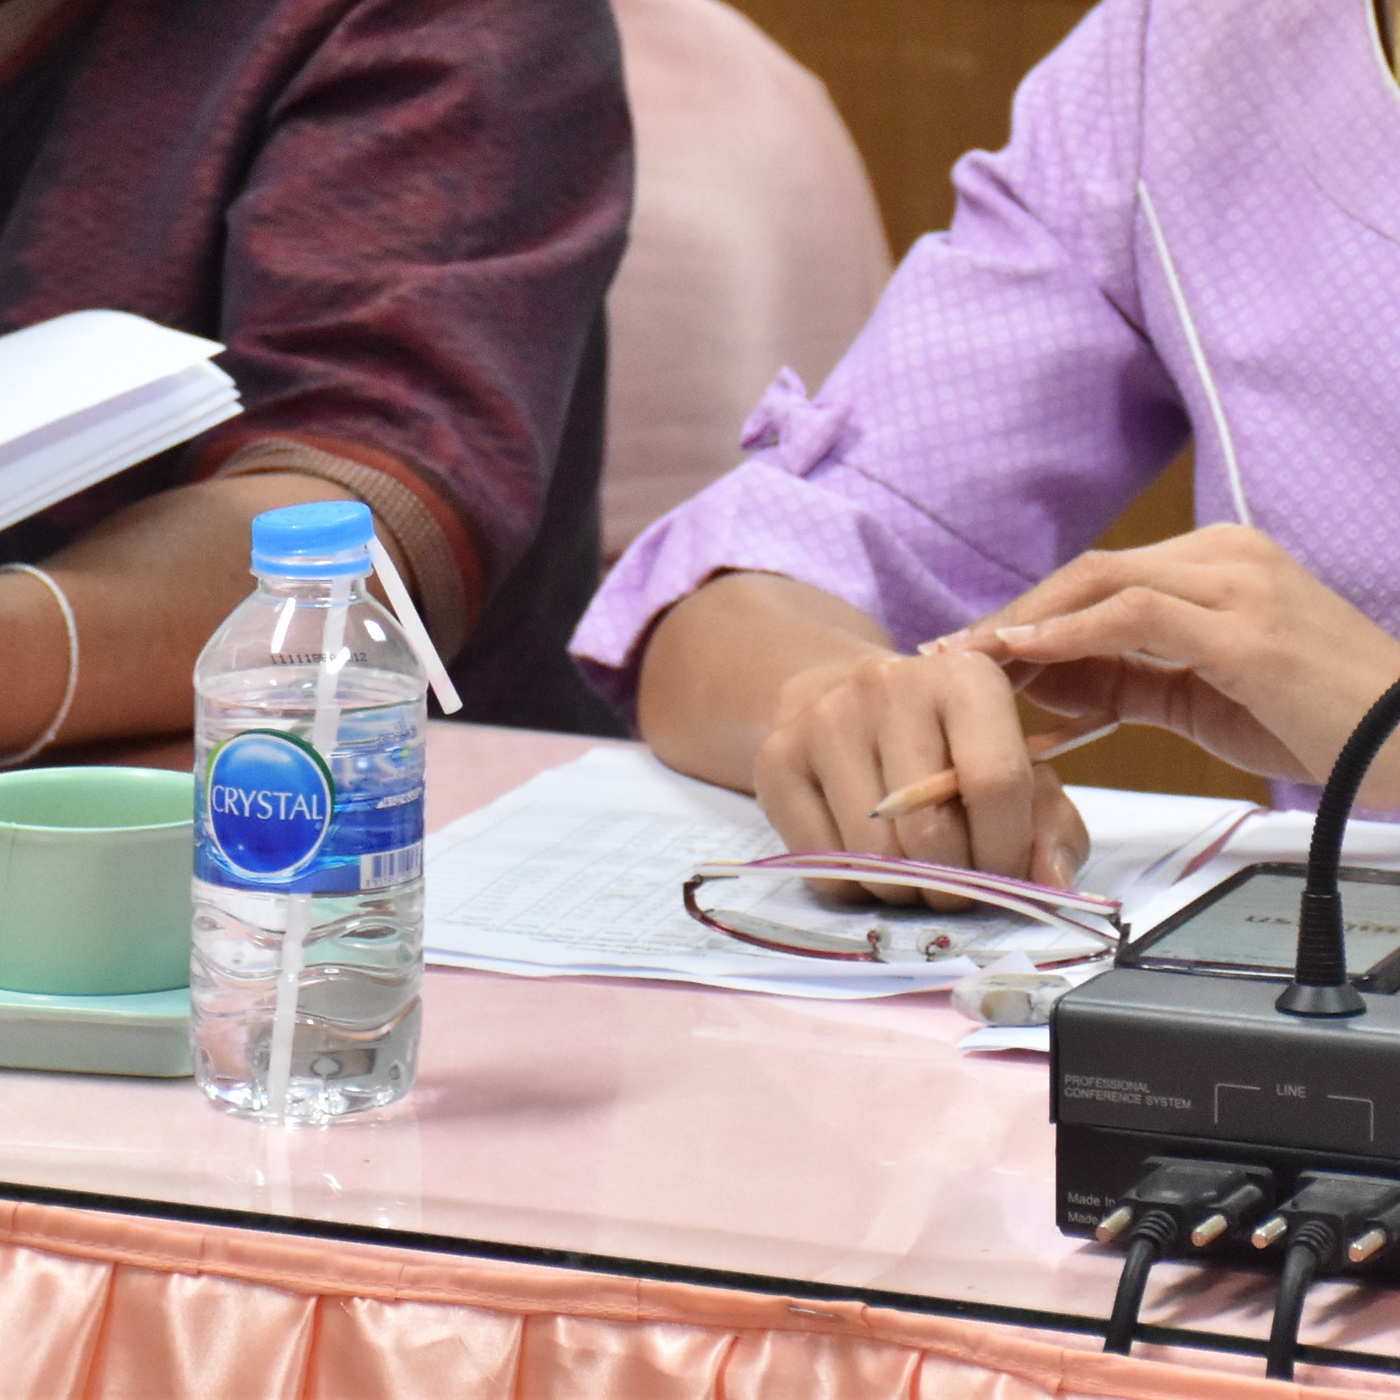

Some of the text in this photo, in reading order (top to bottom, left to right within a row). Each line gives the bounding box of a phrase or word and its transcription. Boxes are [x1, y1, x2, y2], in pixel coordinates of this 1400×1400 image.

[212, 784, 324, 820] CRYSTAL
[1064, 1074, 1150, 1093] PROFESSIONAL
[1275, 1084, 1307, 1098] LINE
[1064, 1087, 1192, 1109] CONFERENCE SYSTEM
[1067, 1191, 1100, 1207] Made
